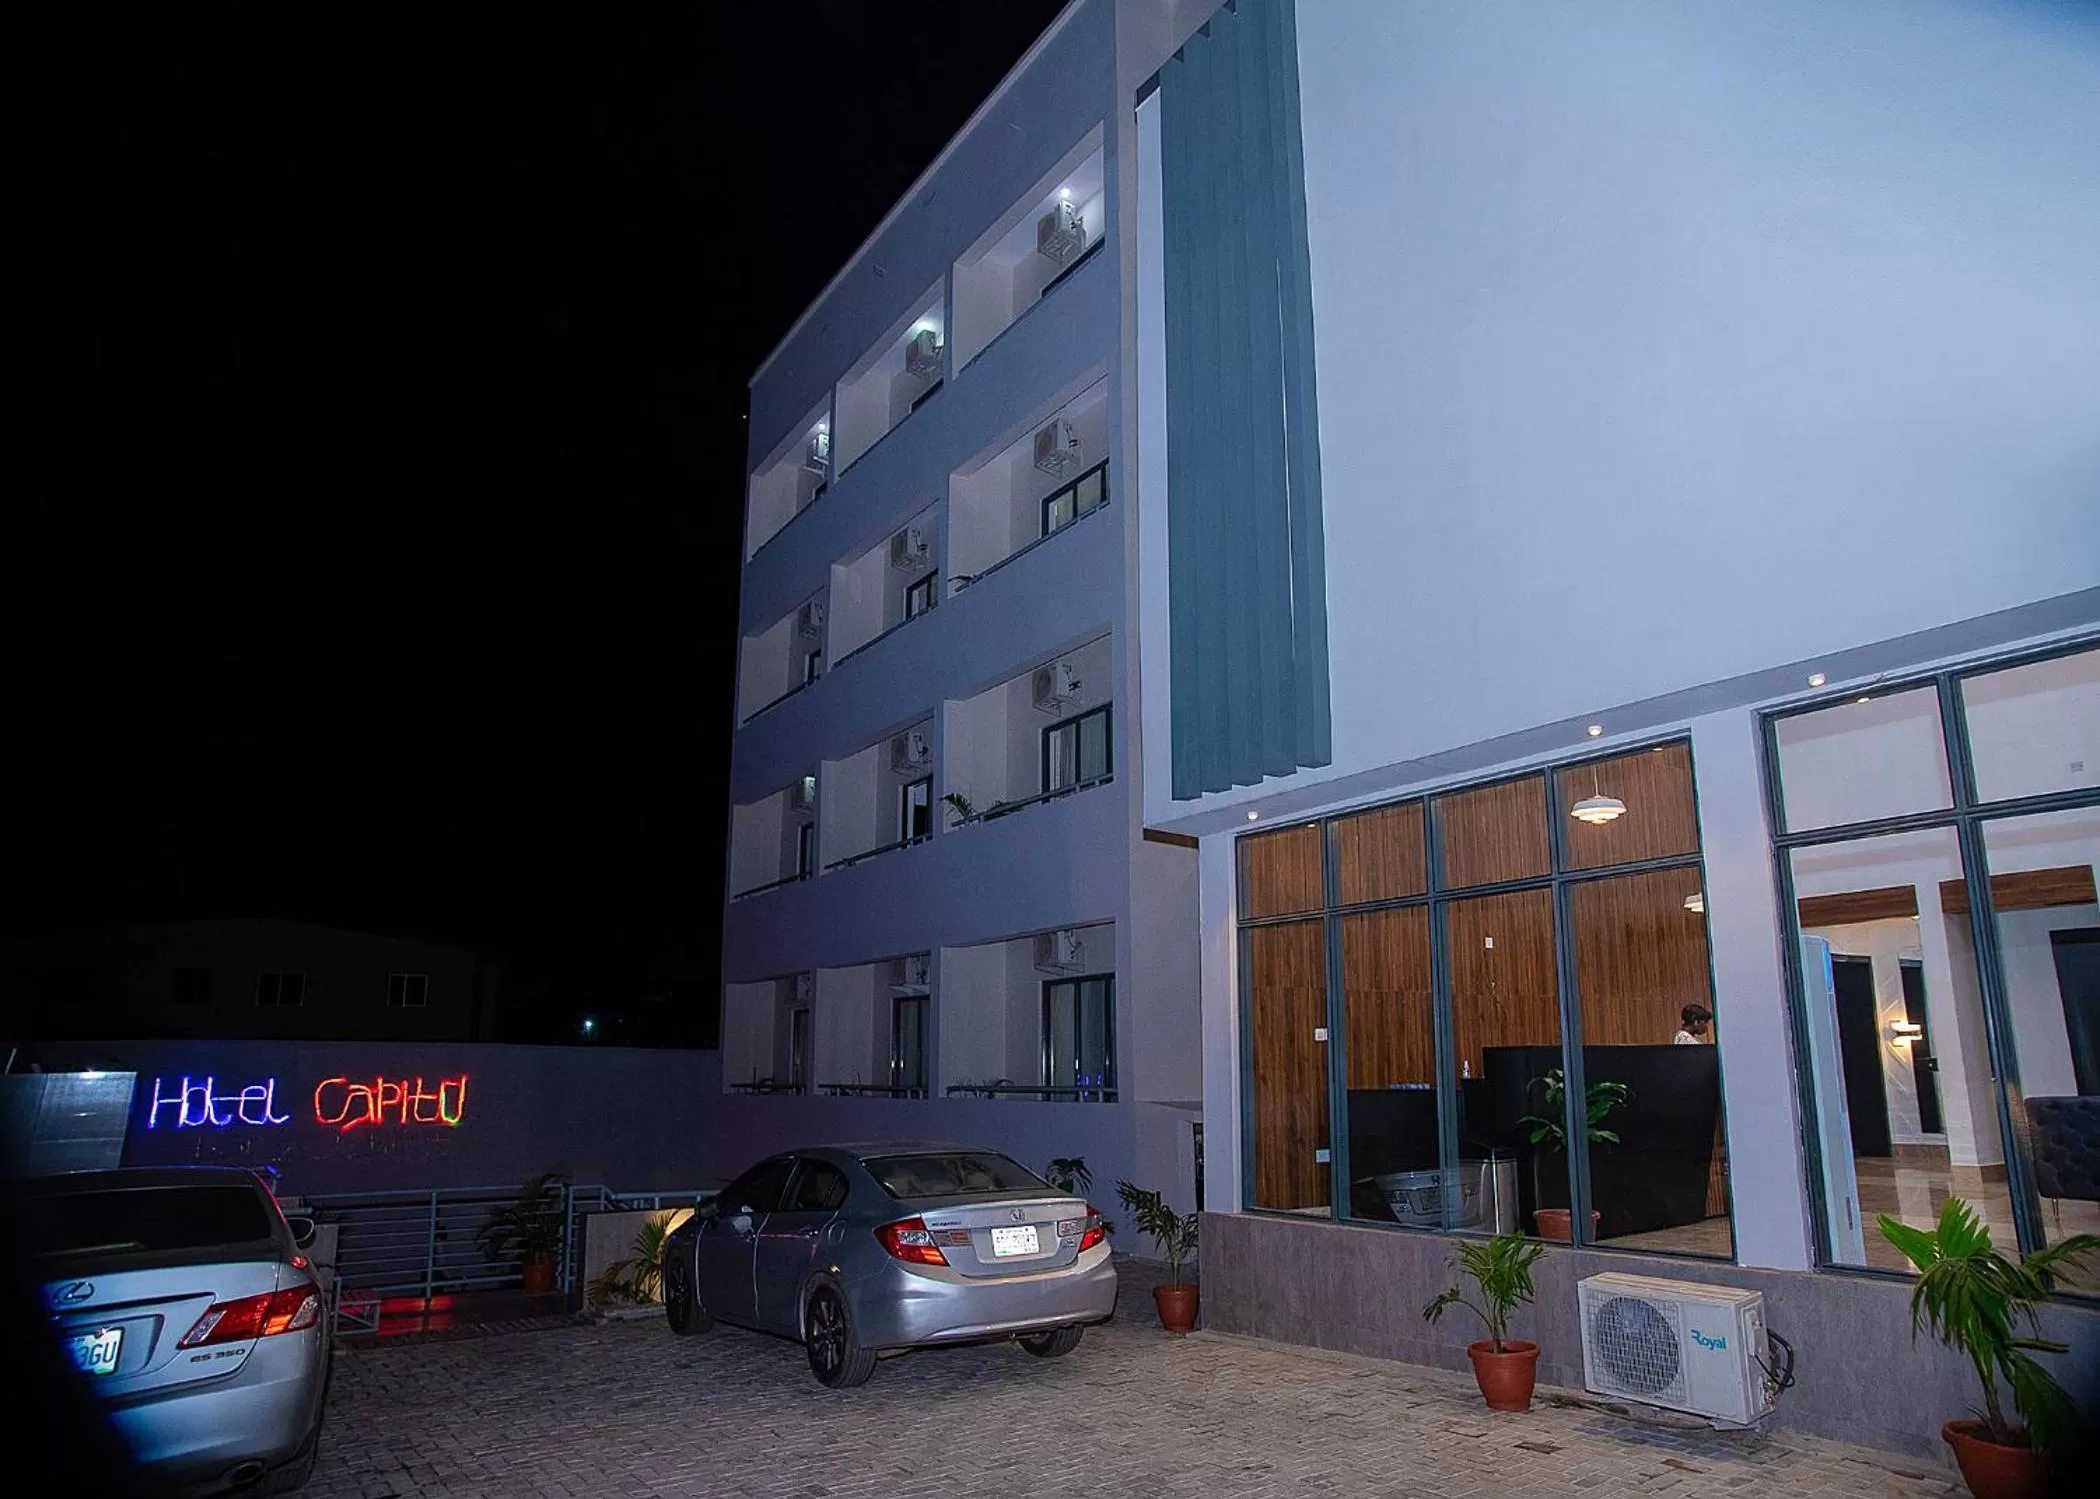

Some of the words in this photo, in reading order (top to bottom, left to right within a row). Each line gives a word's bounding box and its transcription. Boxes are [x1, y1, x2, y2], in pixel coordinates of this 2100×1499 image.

[149, 1076, 290, 1129] Hotel
[1690, 1329, 1727, 1351] Royal
[214, 1348, 246, 1358] 350
